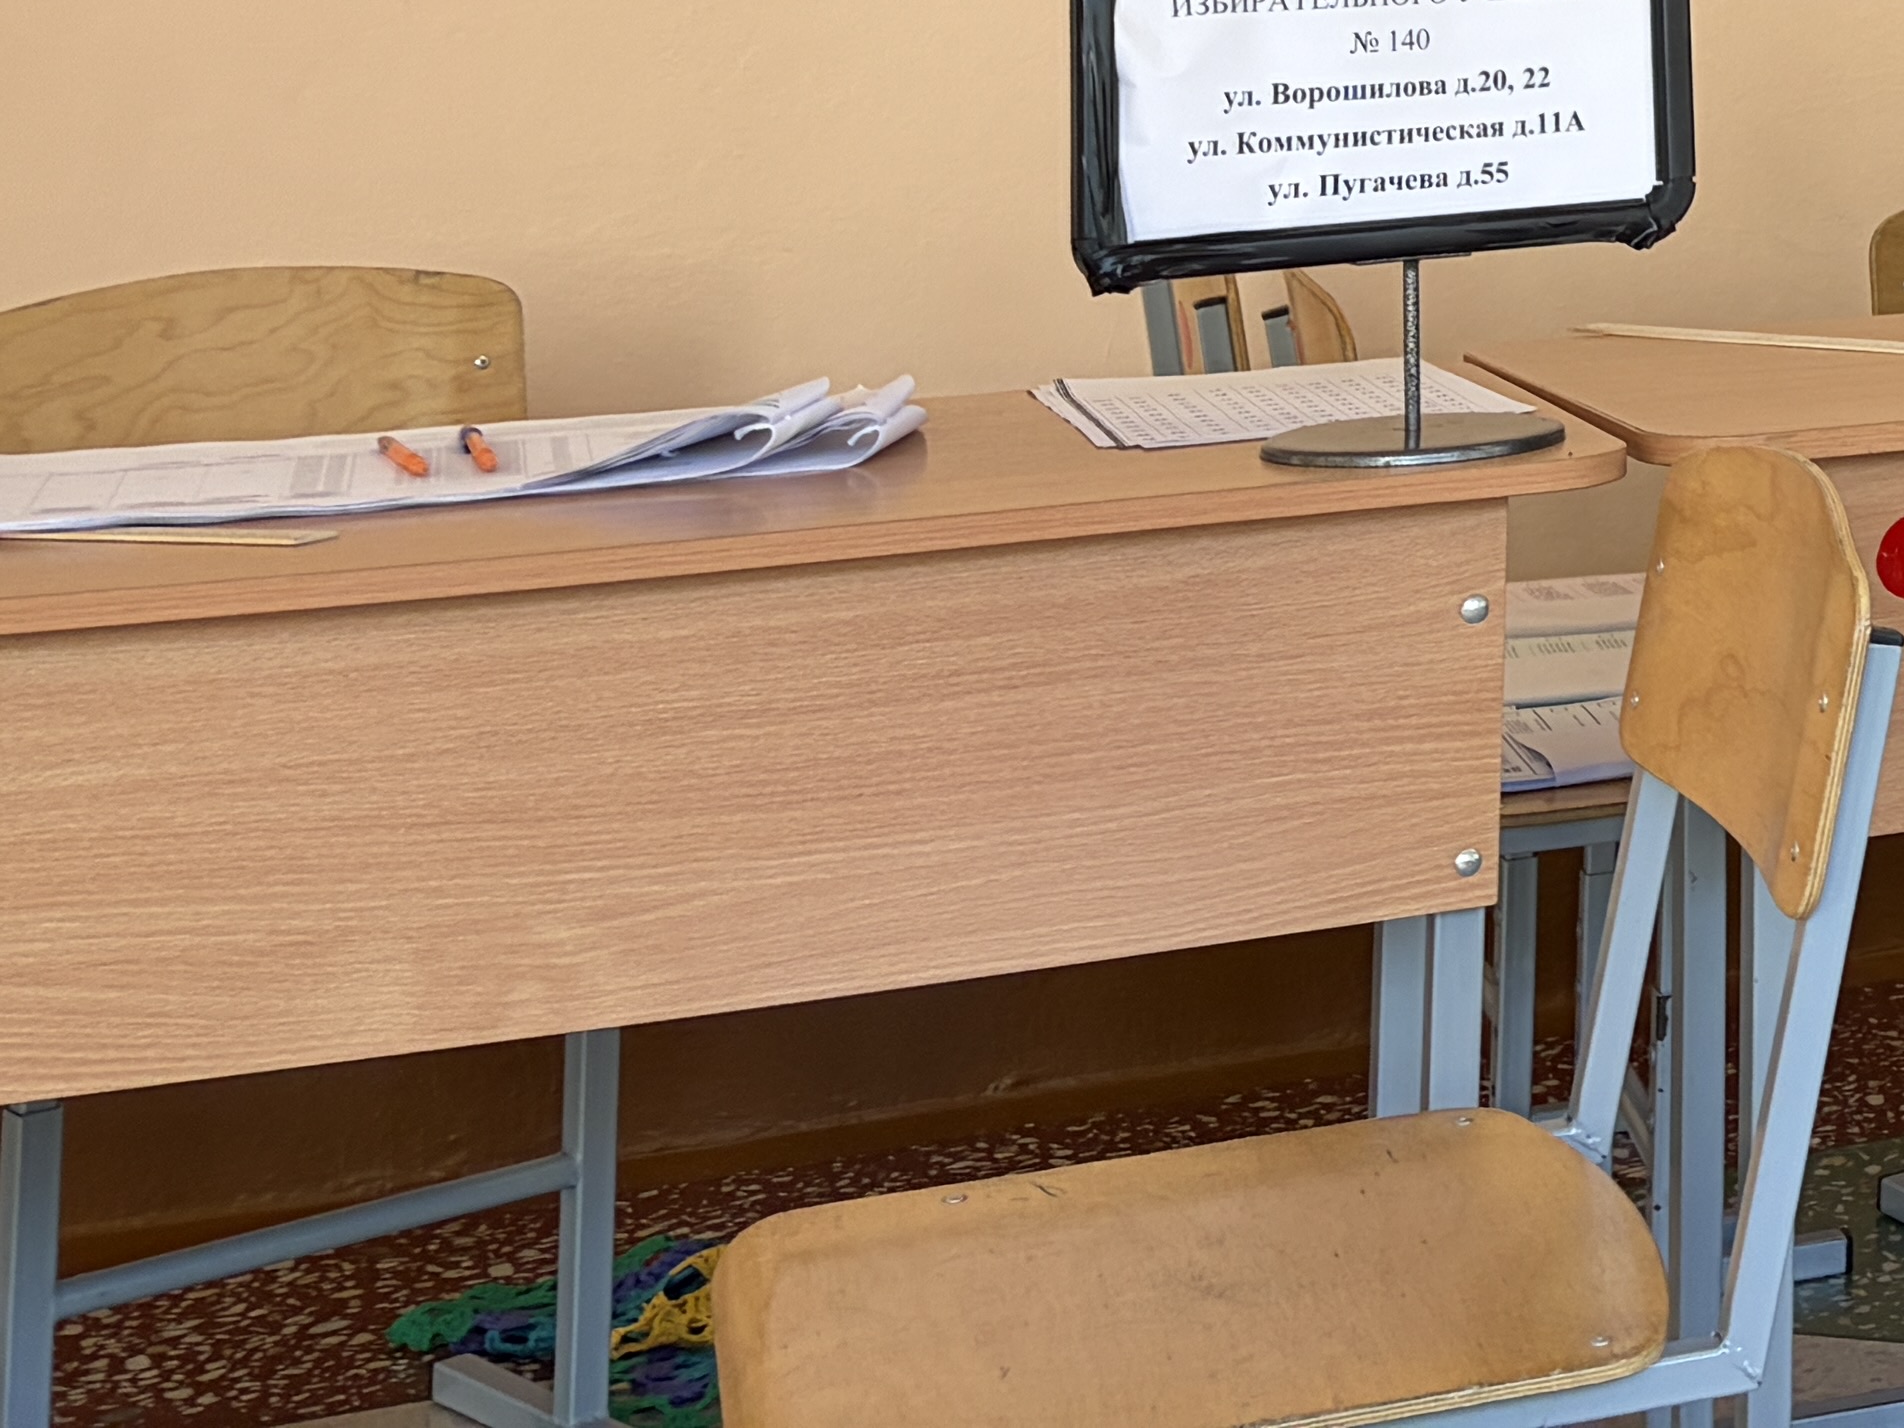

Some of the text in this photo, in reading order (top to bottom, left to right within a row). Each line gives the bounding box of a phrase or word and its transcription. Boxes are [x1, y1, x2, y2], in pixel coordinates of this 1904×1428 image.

[1350, 28, 1431, 55] № 140
[1223, 66, 1552, 114] ул. Ворошилова д.20, 22
[1186, 110, 1586, 166] ул. Коммунистическая д.11А
[1267, 160, 1511, 207] ул. Пугачева д.55
